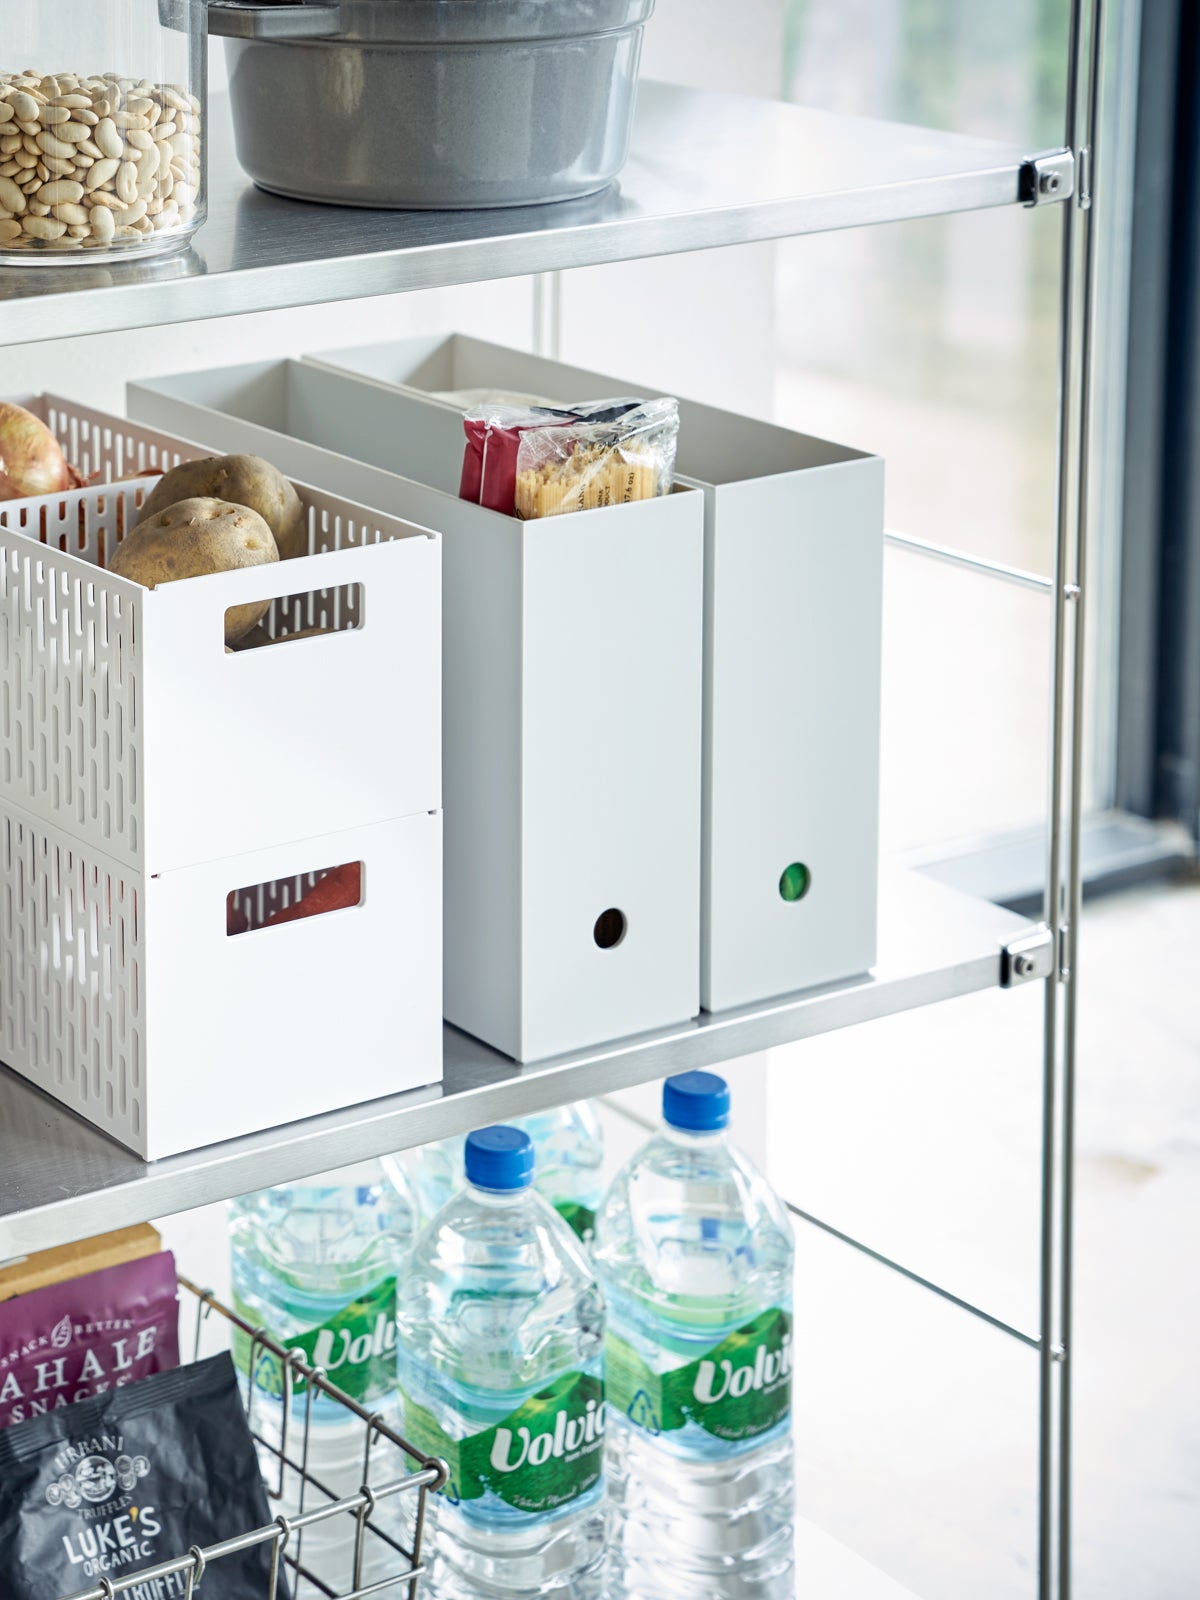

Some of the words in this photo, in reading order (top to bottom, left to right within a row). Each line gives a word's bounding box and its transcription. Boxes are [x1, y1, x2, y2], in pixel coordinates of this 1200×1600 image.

[0, 1335, 49, 1368] SNACK
[74, 1318, 134, 1336] BETTER
[54, 1435, 124, 1470] URBANI
[489, 1399, 608, 1473] Volvic
[77, 1495, 133, 1521] TRUFFLES
[62, 1506, 162, 1565] LUKE'S
[83, 1540, 153, 1577] ORGANIC
